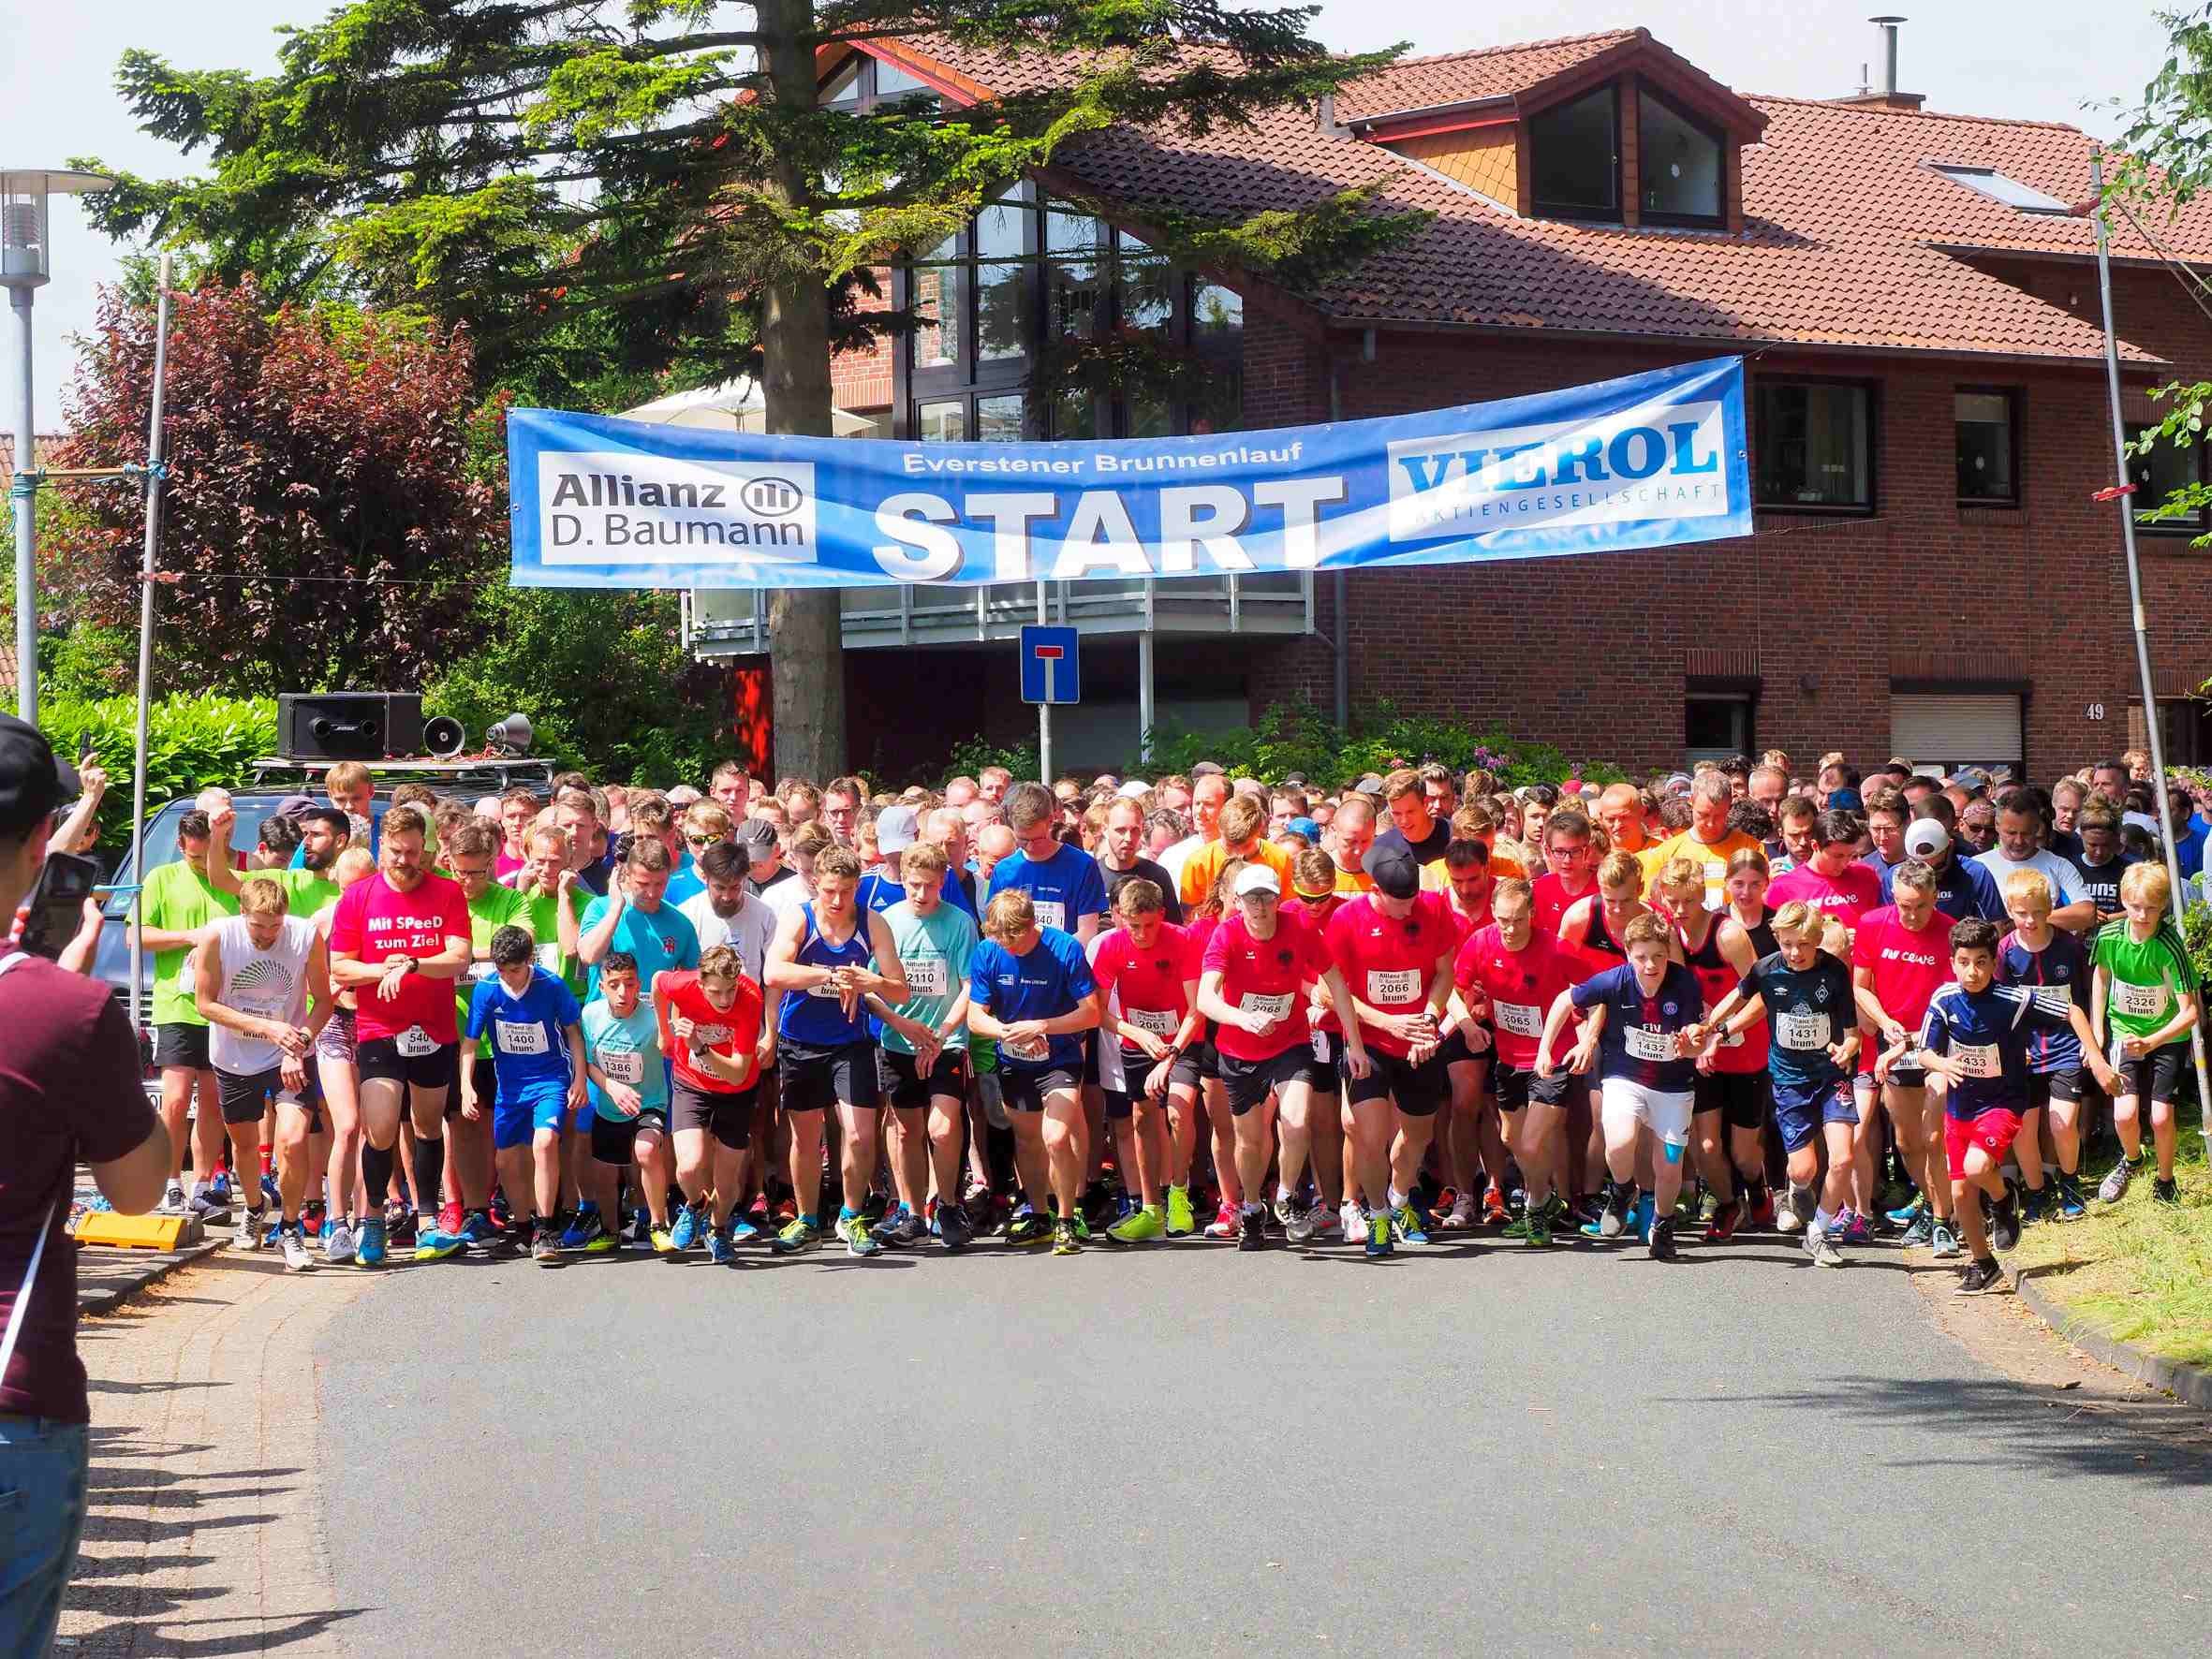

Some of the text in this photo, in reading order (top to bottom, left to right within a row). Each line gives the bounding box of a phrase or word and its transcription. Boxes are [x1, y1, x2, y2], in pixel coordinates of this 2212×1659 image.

[903, 442, 1303, 474] Everstener Brunnenlauf
[1398, 422, 1718, 493] VIEROL
[552, 474, 727, 508] Allianz
[553, 514, 804, 547] D. Baumann
[872, 477, 1348, 582] START
[2087, 703, 2104, 720] 49
[1824, 893, 1858, 906] cewe
[368, 917, 443, 932] Mit SPeeD
[375, 933, 439, 949] zum Ziel
[1901, 951, 1936, 965] cewe
[907, 973, 935, 983] 2110
[1379, 983, 1409, 993] 2066
[1382, 993, 1408, 1002] bruns
[2125, 995, 2157, 1006] 2326
[1252, 1004, 1282, 1013] 2068
[2128, 1005, 2155, 1014] bruns
[1139, 1020, 1166, 1030] 2061
[1503, 1014, 1531, 1026] 2065
[409, 1033, 429, 1043] 540
[1789, 1029, 1818, 1038] 1431
[507, 1034, 535, 1044] 1400
[1790, 1038, 1816, 1048] bruns
[407, 1043, 432, 1052] bruns
[509, 1044, 534, 1052] bruns
[1637, 1041, 1666, 1052] 1432
[1638, 1049, 1664, 1060] bruns
[1963, 1057, 1986, 1066] 433
[605, 1062, 631, 1072] 1386
